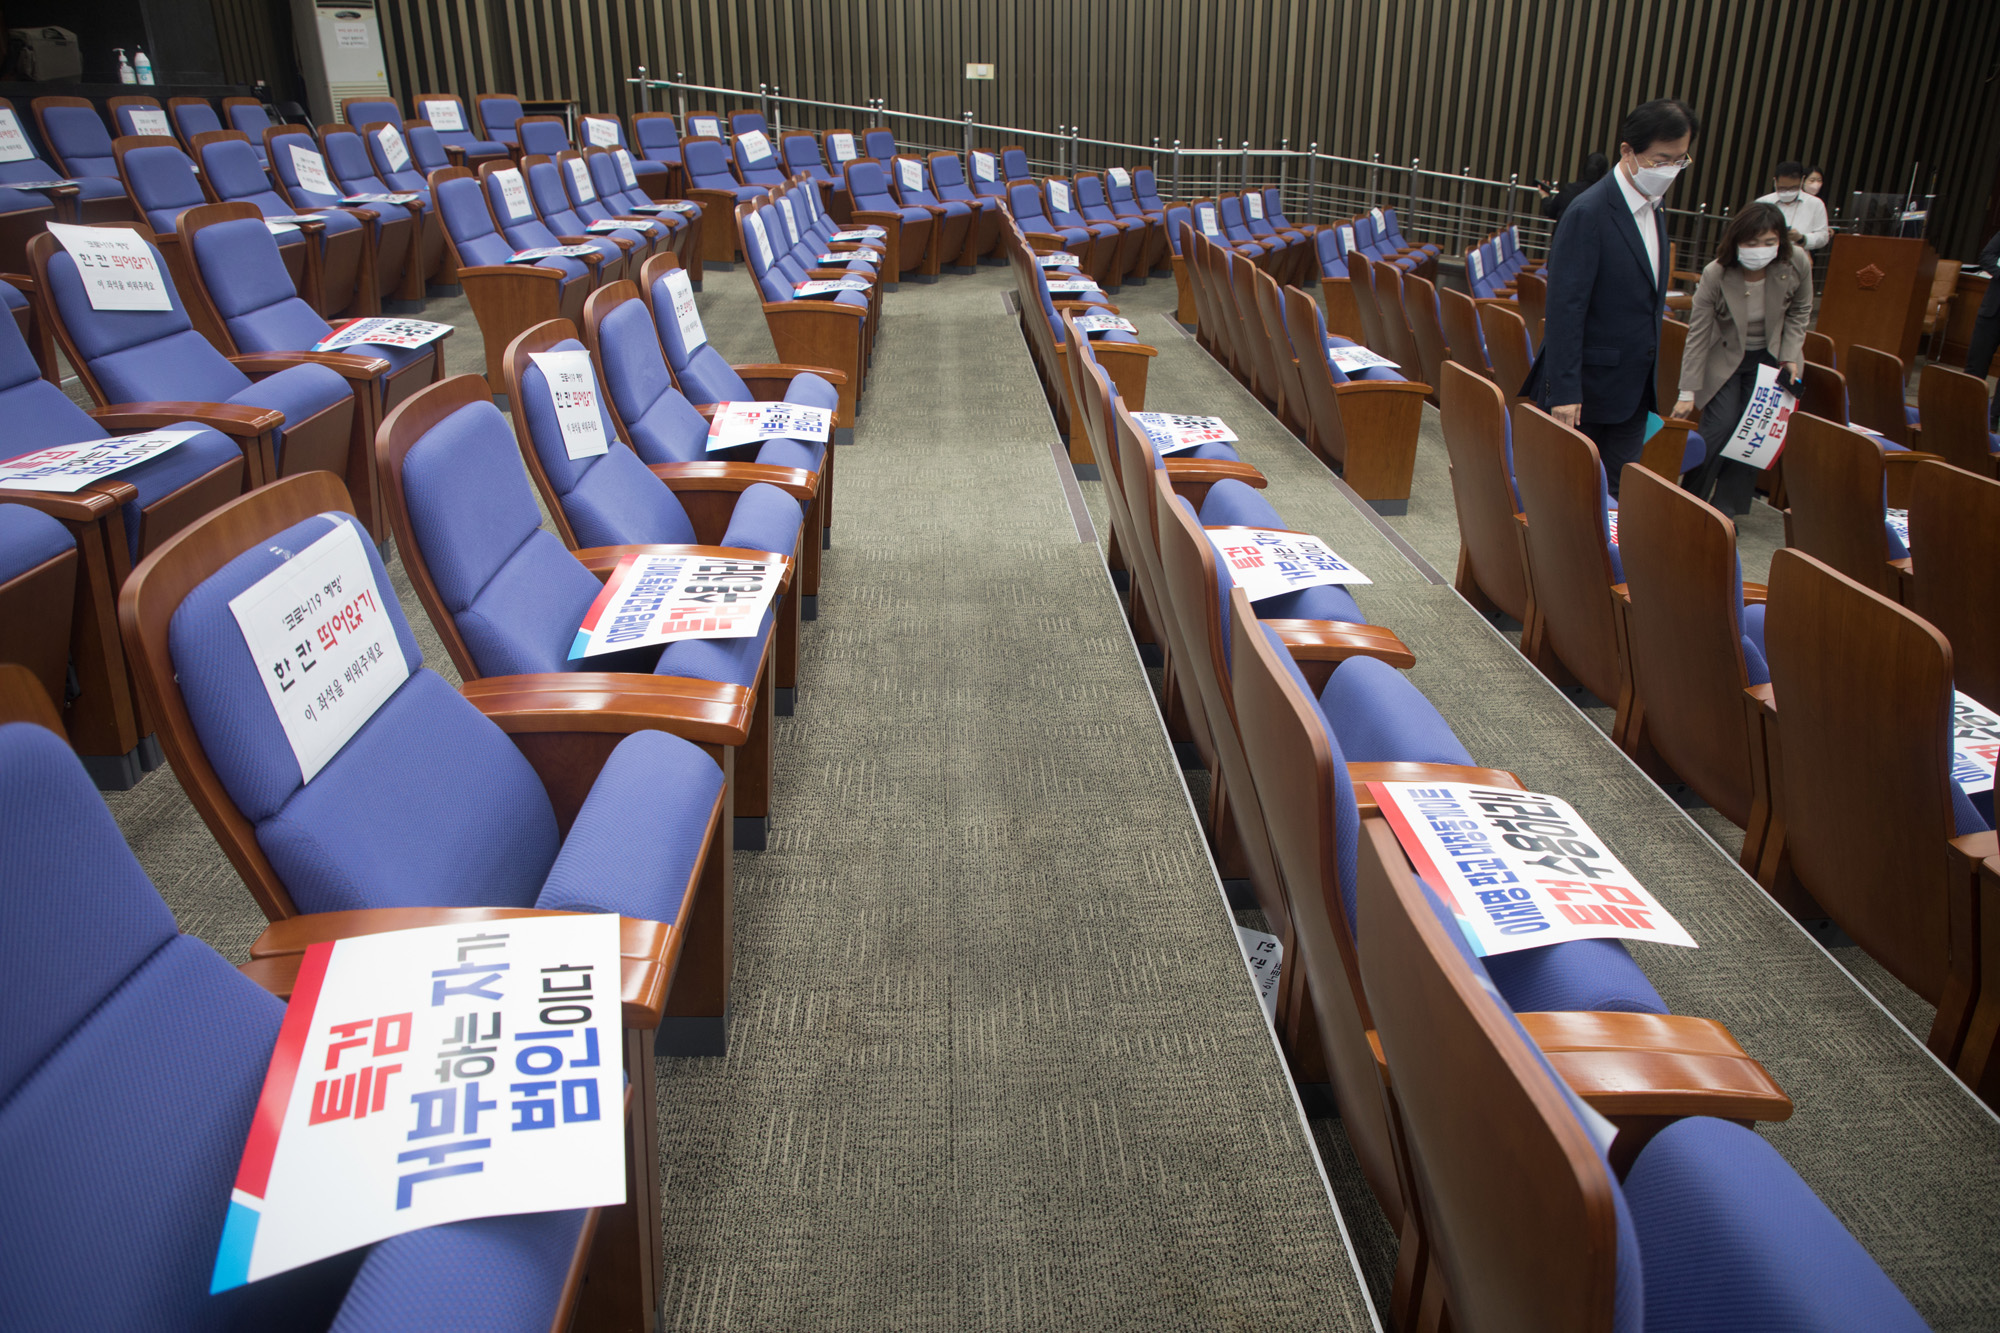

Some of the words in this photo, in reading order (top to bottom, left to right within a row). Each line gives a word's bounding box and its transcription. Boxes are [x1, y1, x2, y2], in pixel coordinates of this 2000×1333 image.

[79, 253, 94, 267] 한
[95, 254, 110, 268] 칸
[111, 255, 154, 270] 띄어앉기
[97, 280, 105, 289] 이
[1737, 386, 1770, 440] 범인이다
[1769, 406, 1790, 439] 특검
[65, 440, 171, 475] 범인이다
[1741, 432, 1766, 458] 자가
[1252, 532, 1286, 547] 자가
[1297, 541, 1349, 571] 범인이다
[1223, 546, 1265, 570] 특검
[1273, 547, 1317, 585] 거부하는
[605, 612, 656, 644] 이재명
[661, 604, 752, 634] 특검
[273, 658, 295, 692] 한
[295, 639, 317, 673] 칸
[316, 588, 378, 652] 띄어앉기
[304, 704, 317, 723] 이
[316, 680, 345, 712] 좌석을
[344, 642, 385, 683] 비워주세요
[1407, 788, 1496, 857] 대장동게이트
[1469, 789, 1614, 880] 수용하라!
[1456, 857, 1520, 888] 판교
[1475, 887, 1551, 936] 이재명
[1536, 878, 1657, 930] 특검
[1256, 941, 1276, 953] 한
[431, 932, 510, 1007] 자가
[510, 964, 602, 1133] 범인이다
[308, 1011, 413, 1127] 특검
[396, 1010, 502, 1211] 거부하는
